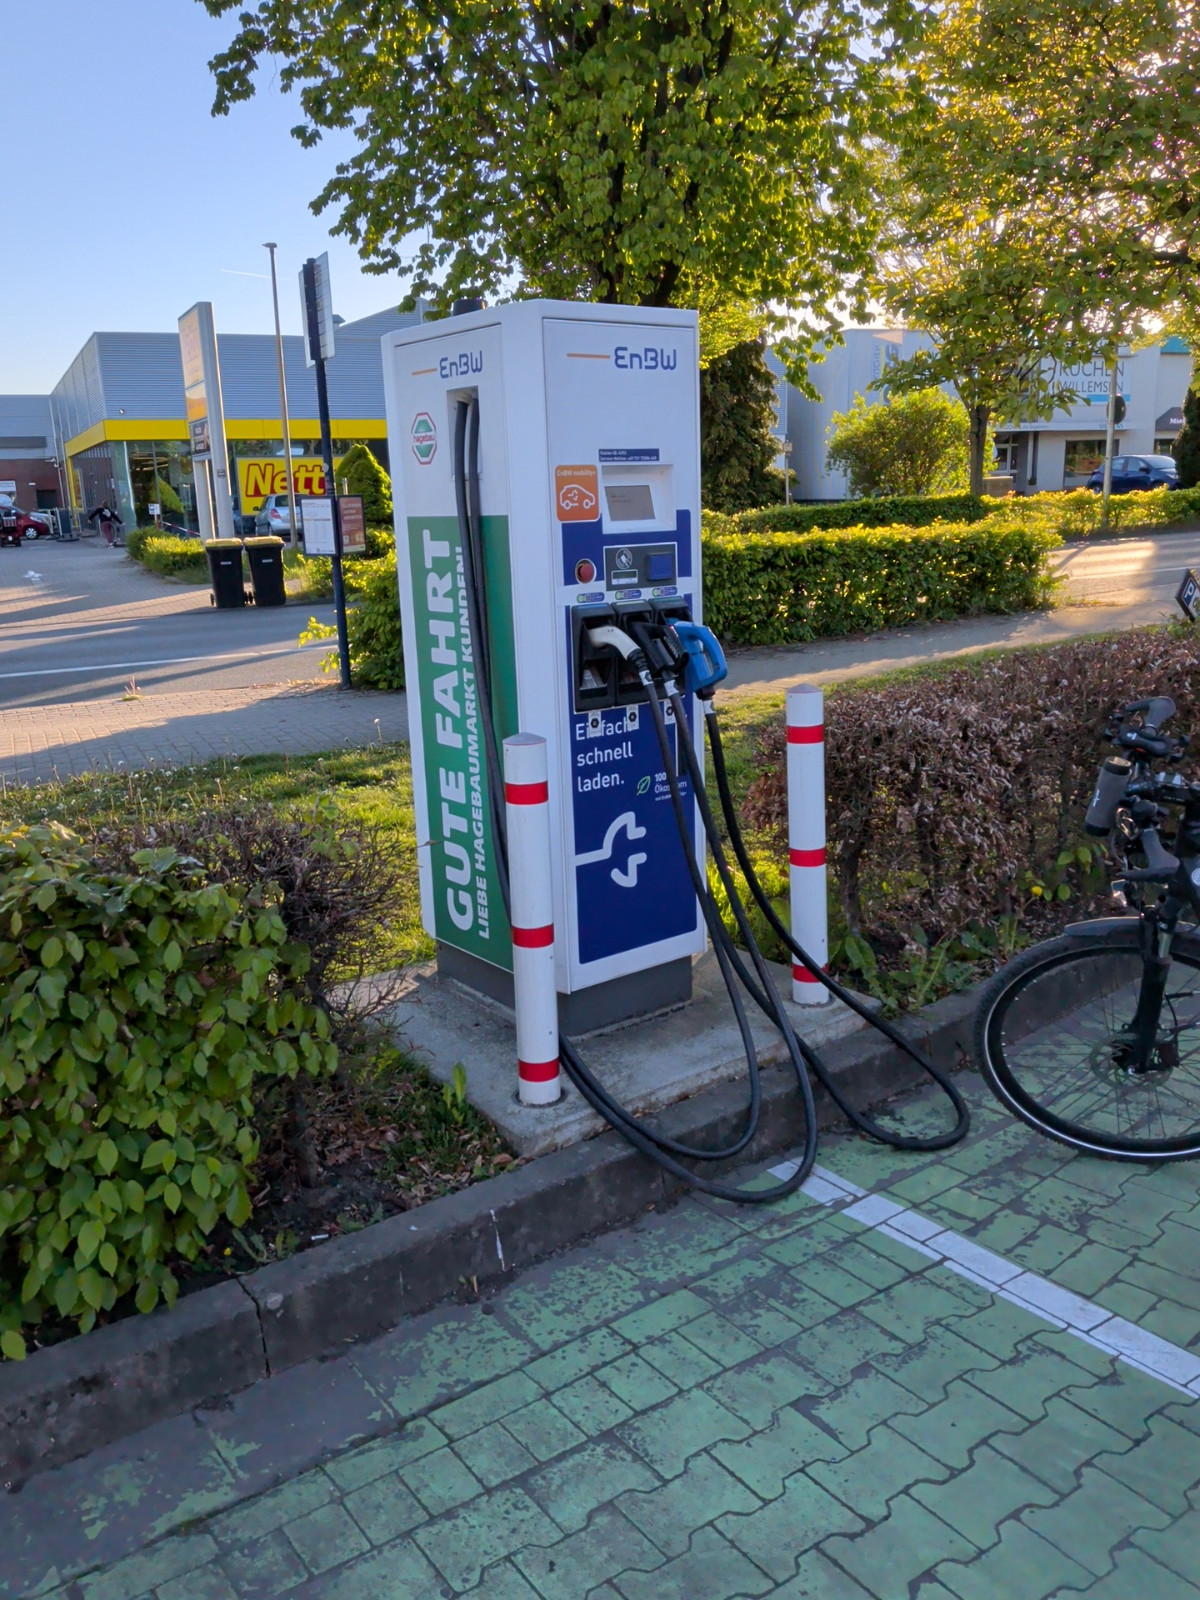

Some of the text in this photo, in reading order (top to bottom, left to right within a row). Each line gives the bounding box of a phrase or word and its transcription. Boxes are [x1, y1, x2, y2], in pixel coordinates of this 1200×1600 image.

[440, 350, 483, 379] EnBW
[614, 346, 677, 371] EnBW
[423, 529, 474, 931] GUTE FAHRT
[577, 741, 633, 767] schnell
[462, 667, 486, 872] HAGEBAUMARKT
[577, 772, 625, 792] laden.
[475, 875, 490, 939] LIEBE
